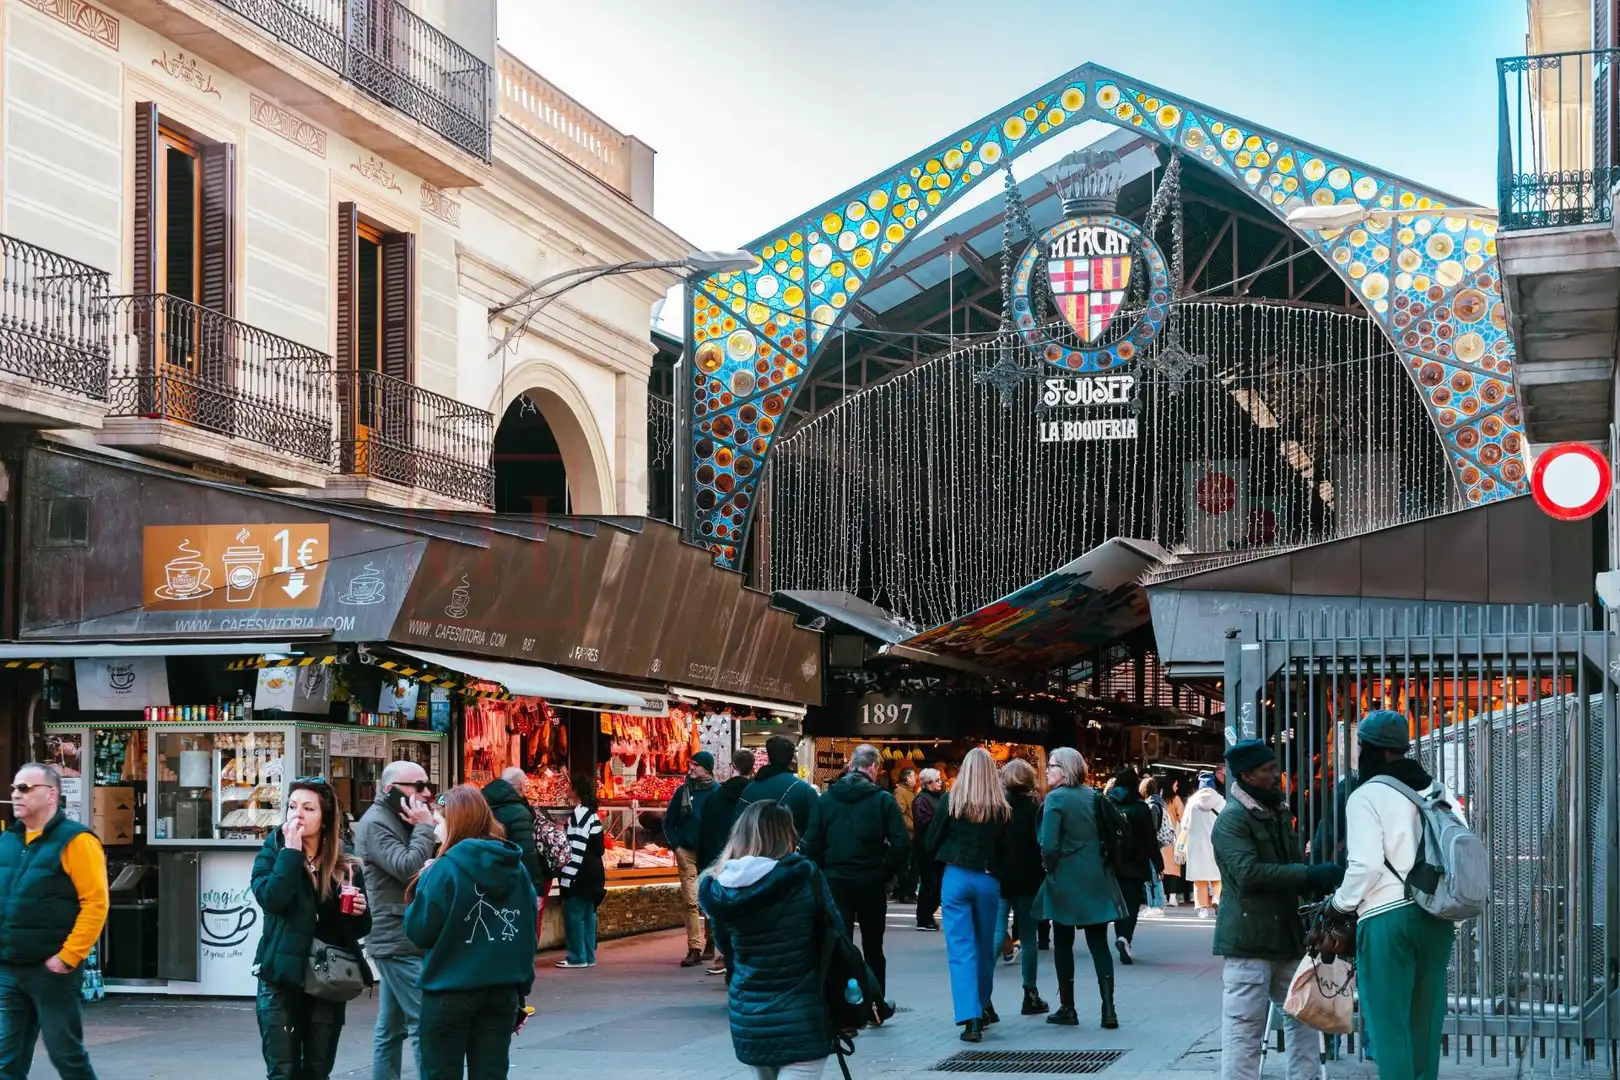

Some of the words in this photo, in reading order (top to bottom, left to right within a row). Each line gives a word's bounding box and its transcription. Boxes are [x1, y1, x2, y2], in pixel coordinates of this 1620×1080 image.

[1050, 226, 1131, 259] MERCAT
[1065, 375, 1135, 405] JOSEP
[1040, 421, 1060, 443] LA
[1063, 417, 1139, 442] BOQUERIA
[521, 637, 536, 653] 887
[862, 703, 913, 725] 1897
